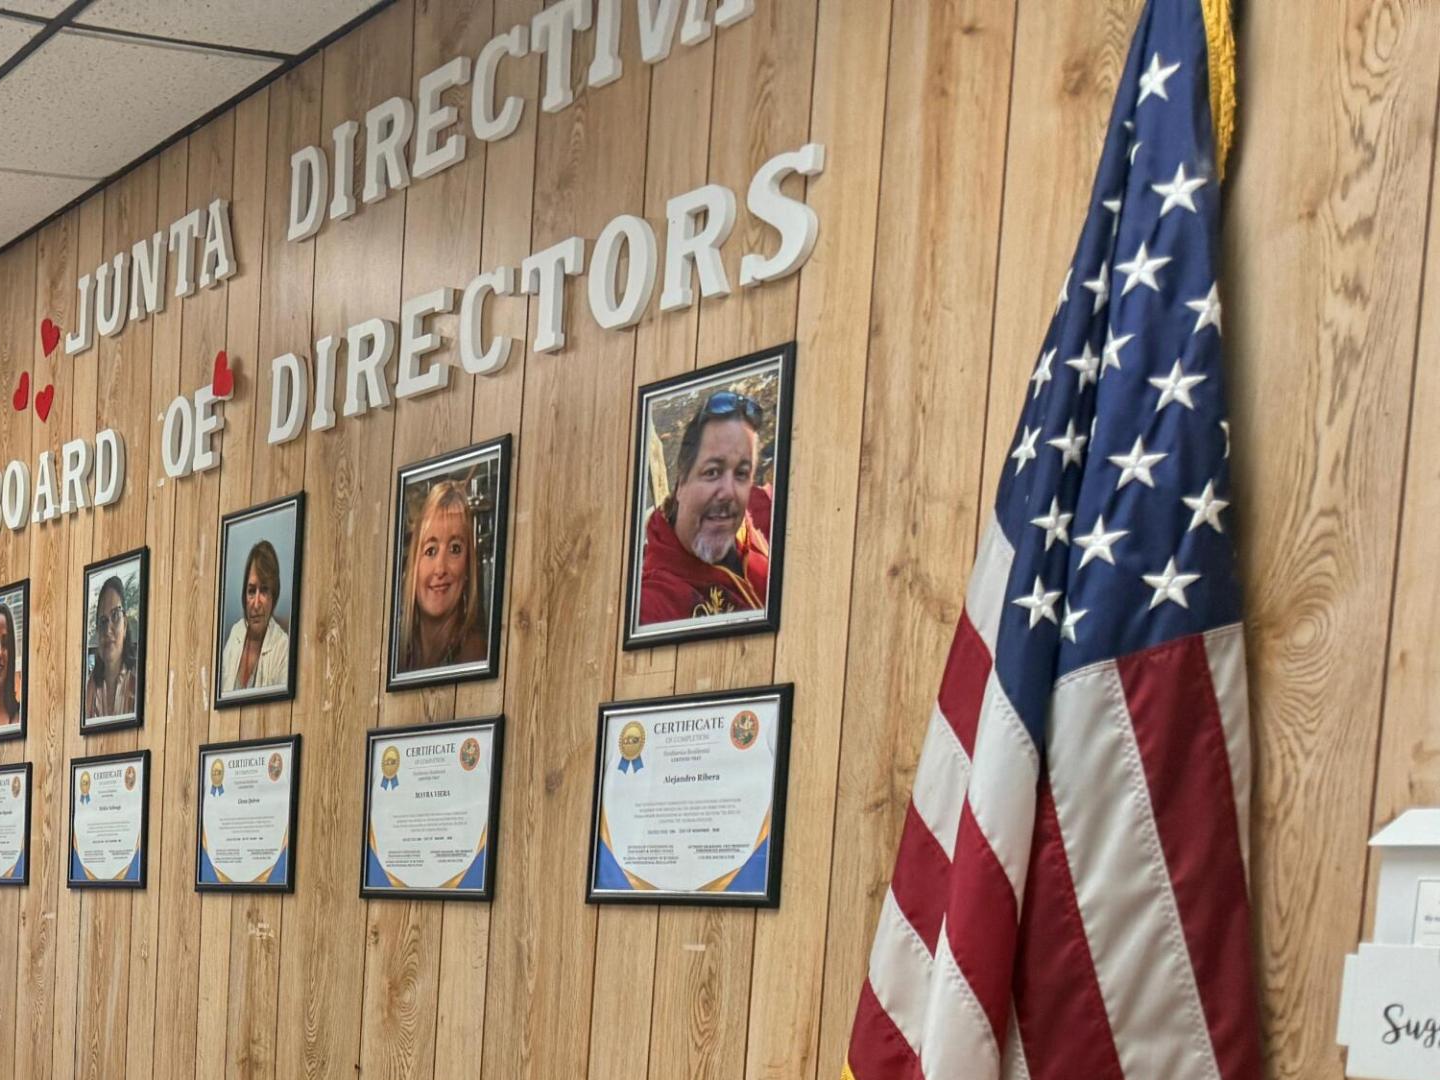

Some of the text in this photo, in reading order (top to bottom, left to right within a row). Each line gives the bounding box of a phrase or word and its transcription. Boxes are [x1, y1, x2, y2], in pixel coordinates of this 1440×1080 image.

[65, 198, 238, 356] JUNTA
[267, 143, 825, 446] DIRECTORS
[654, 717, 724, 735] CERTIFICATE
[406, 743, 456, 758] CERTIFICATE
[1382, 1003, 1440, 1049] Sug
